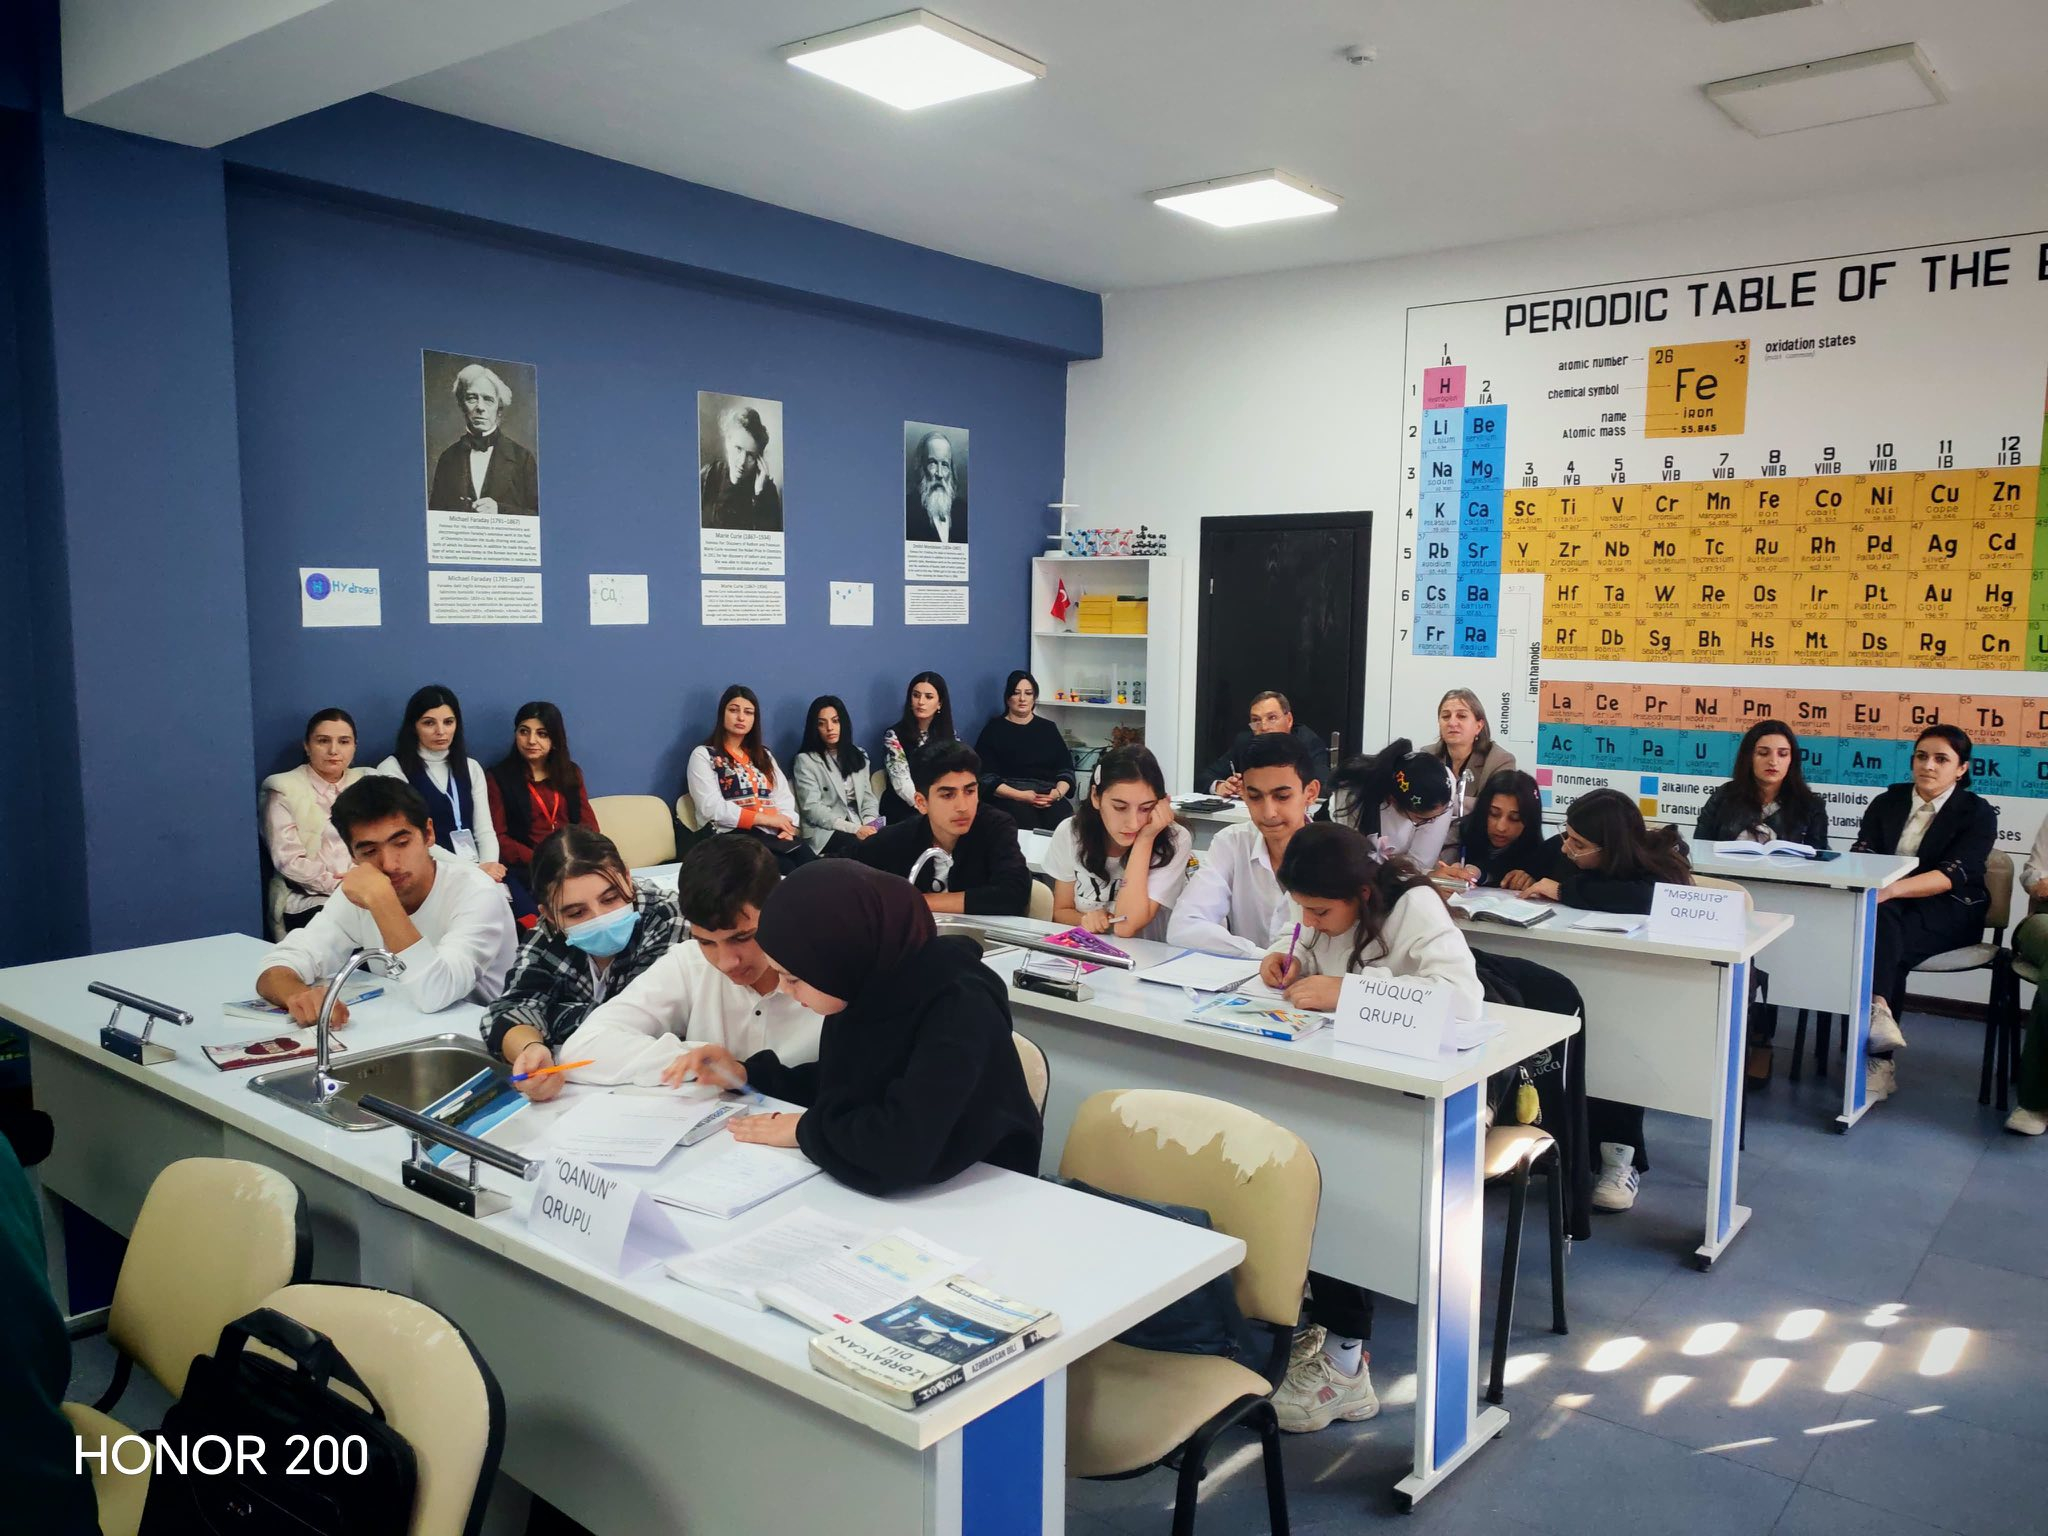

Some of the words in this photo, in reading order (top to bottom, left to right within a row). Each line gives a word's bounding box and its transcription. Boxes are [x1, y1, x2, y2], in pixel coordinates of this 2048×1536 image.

[1505, 288, 1669, 337] PERIODIC
[1687, 271, 1817, 319] TABLE
[1838, 261, 1897, 302] OF
[1921, 247, 2011, 293] THE
[1444, 343, 1447, 356] 1
[1735, 341, 1746, 350] +3
[1765, 337, 1815, 353] oxidation
[1818, 335, 1856, 348] states
[1441, 356, 1452, 366] IA
[1558, 360, 1589, 371] atomic
[1593, 356, 1629, 368] number
[1655, 349, 1673, 364] 26
[1734, 355, 1745, 364] +2
[1412, 384, 1416, 396] 1
[1440, 378, 1450, 394] H
[1482, 380, 1490, 392] 2
[1548, 387, 1586, 399] chemical
[1588, 384, 1619, 397] symbol
[1676, 368, 1718, 402] Fe
[1479, 393, 1492, 404] IIA
[1601, 413, 1627, 422] name
[1409, 426, 1417, 438] 2
[1434, 420, 1448, 435] Li
[1473, 418, 1495, 434] Be
[1562, 428, 1596, 438] Atomic
[1600, 426, 1626, 437] mass
[1681, 424, 1717, 433] 55.845
[1877, 443, 1893, 458] 10
[1940, 440, 1952, 454] 11
[2002, 436, 2020, 451] 12
[1664, 455, 1674, 469] 6
[1720, 453, 1729, 466] 7
[1769, 450, 1781, 464] 8
[1823, 447, 1835, 461] 9
[1433, 462, 1452, 478] Na
[1472, 460, 1493, 478] Mg
[1525, 462, 1534, 475] 3
[1567, 461, 1575, 473] 4
[1615, 458, 1623, 471] 5
[1408, 467, 1415, 479] 3
[1815, 489, 1842, 508] Co
[1871, 486, 1893, 505] Ni
[1931, 484, 1959, 503] Cu
[1993, 481, 2020, 502] Zn
[1514, 500, 1536, 516] Sc
[1561, 498, 1575, 515] Ti
[1612, 497, 1623, 513] V
[1656, 495, 1679, 513] Cr
[1707, 492, 1730, 510] Mn
[1759, 491, 1780, 509] Fe
[1406, 508, 1413, 519] 4
[1435, 502, 1445, 518] K
[1468, 502, 1489, 517] Ca
[1468, 542, 1489, 558] Sr
[1518, 542, 1528, 558] Y
[1559, 542, 1581, 557] Zr
[1605, 541, 1629, 557] Nb
[1653, 540, 1676, 557] Mo
[1705, 539, 1724, 555] Tc
[1755, 538, 1778, 555] Ru
[1811, 537, 1835, 554] Rh
[1868, 535, 1892, 553] Pd
[1928, 534, 1957, 558] Ag
[1989, 533, 2016, 551] Cd
[1404, 548, 1411, 559] 5
[1429, 543, 1449, 559] Rb
[1402, 590, 1410, 601] 6
[1427, 585, 1446, 601] Cs
[1467, 585, 1488, 601] Ba
[1558, 585, 1579, 601] Hf
[1604, 585, 1624, 602] Ta
[1655, 585, 1675, 602] W
[1702, 585, 1725, 602] Re
[1754, 585, 1776, 602] Os
[1811, 585, 1828, 602] Ir
[1865, 584, 1888, 602] Pt
[1925, 584, 1952, 602] Au
[1986, 584, 2014, 607] Hg
[1400, 629, 1408, 641] 7
[1427, 626, 1445, 641] Fr
[1465, 627, 1486, 642] Ra
[1557, 628, 1577, 644] Rf
[1602, 629, 1623, 645] Db
[1649, 630, 1671, 651] Sg
[1699, 630, 1721, 647] Bh
[1751, 631, 1774, 648] Hs
[1806, 632, 1828, 649] Mt
[1862, 632, 1888, 650] Ds
[1920, 633, 1947, 656] Rg
[1982, 634, 2010, 652] Cn
[1528, 641, 1540, 695] lanthanoids
[1553, 693, 1571, 709] La
[1596, 694, 1619, 711] Ce
[1645, 696, 1668, 713] Pr
[1695, 698, 1717, 715] Nd
[1744, 700, 1771, 717] Pm
[1500, 692, 1510, 735] actinoids
[1798, 702, 1827, 719] Sm
[1855, 704, 1880, 723] Eu
[1912, 706, 1939, 725] Gd
[1976, 708, 2004, 727] Tb
[1552, 735, 1572, 751] Ac
[1595, 737, 1615, 754] Th
[1643, 740, 1663, 757] Pa
[1696, 743, 1706, 759] U
[1852, 751, 1882, 769] Am
[1973, 758, 2000, 776] Bk
[1556, 774, 1609, 787] nonmetals
[1662, 782, 1700, 794] alkaline
[1671, 907, 1718, 921] QRUPU.
[1358, 979, 1433, 1006] “HÜQUQ”
[1359, 1006, 1416, 1030] QRUPU.
[555, 1157, 617, 1200] “QANUN”
[542, 1195, 591, 1236] QRUPU.
[971, 1349, 1006, 1374] AZƏRBAYCAN
